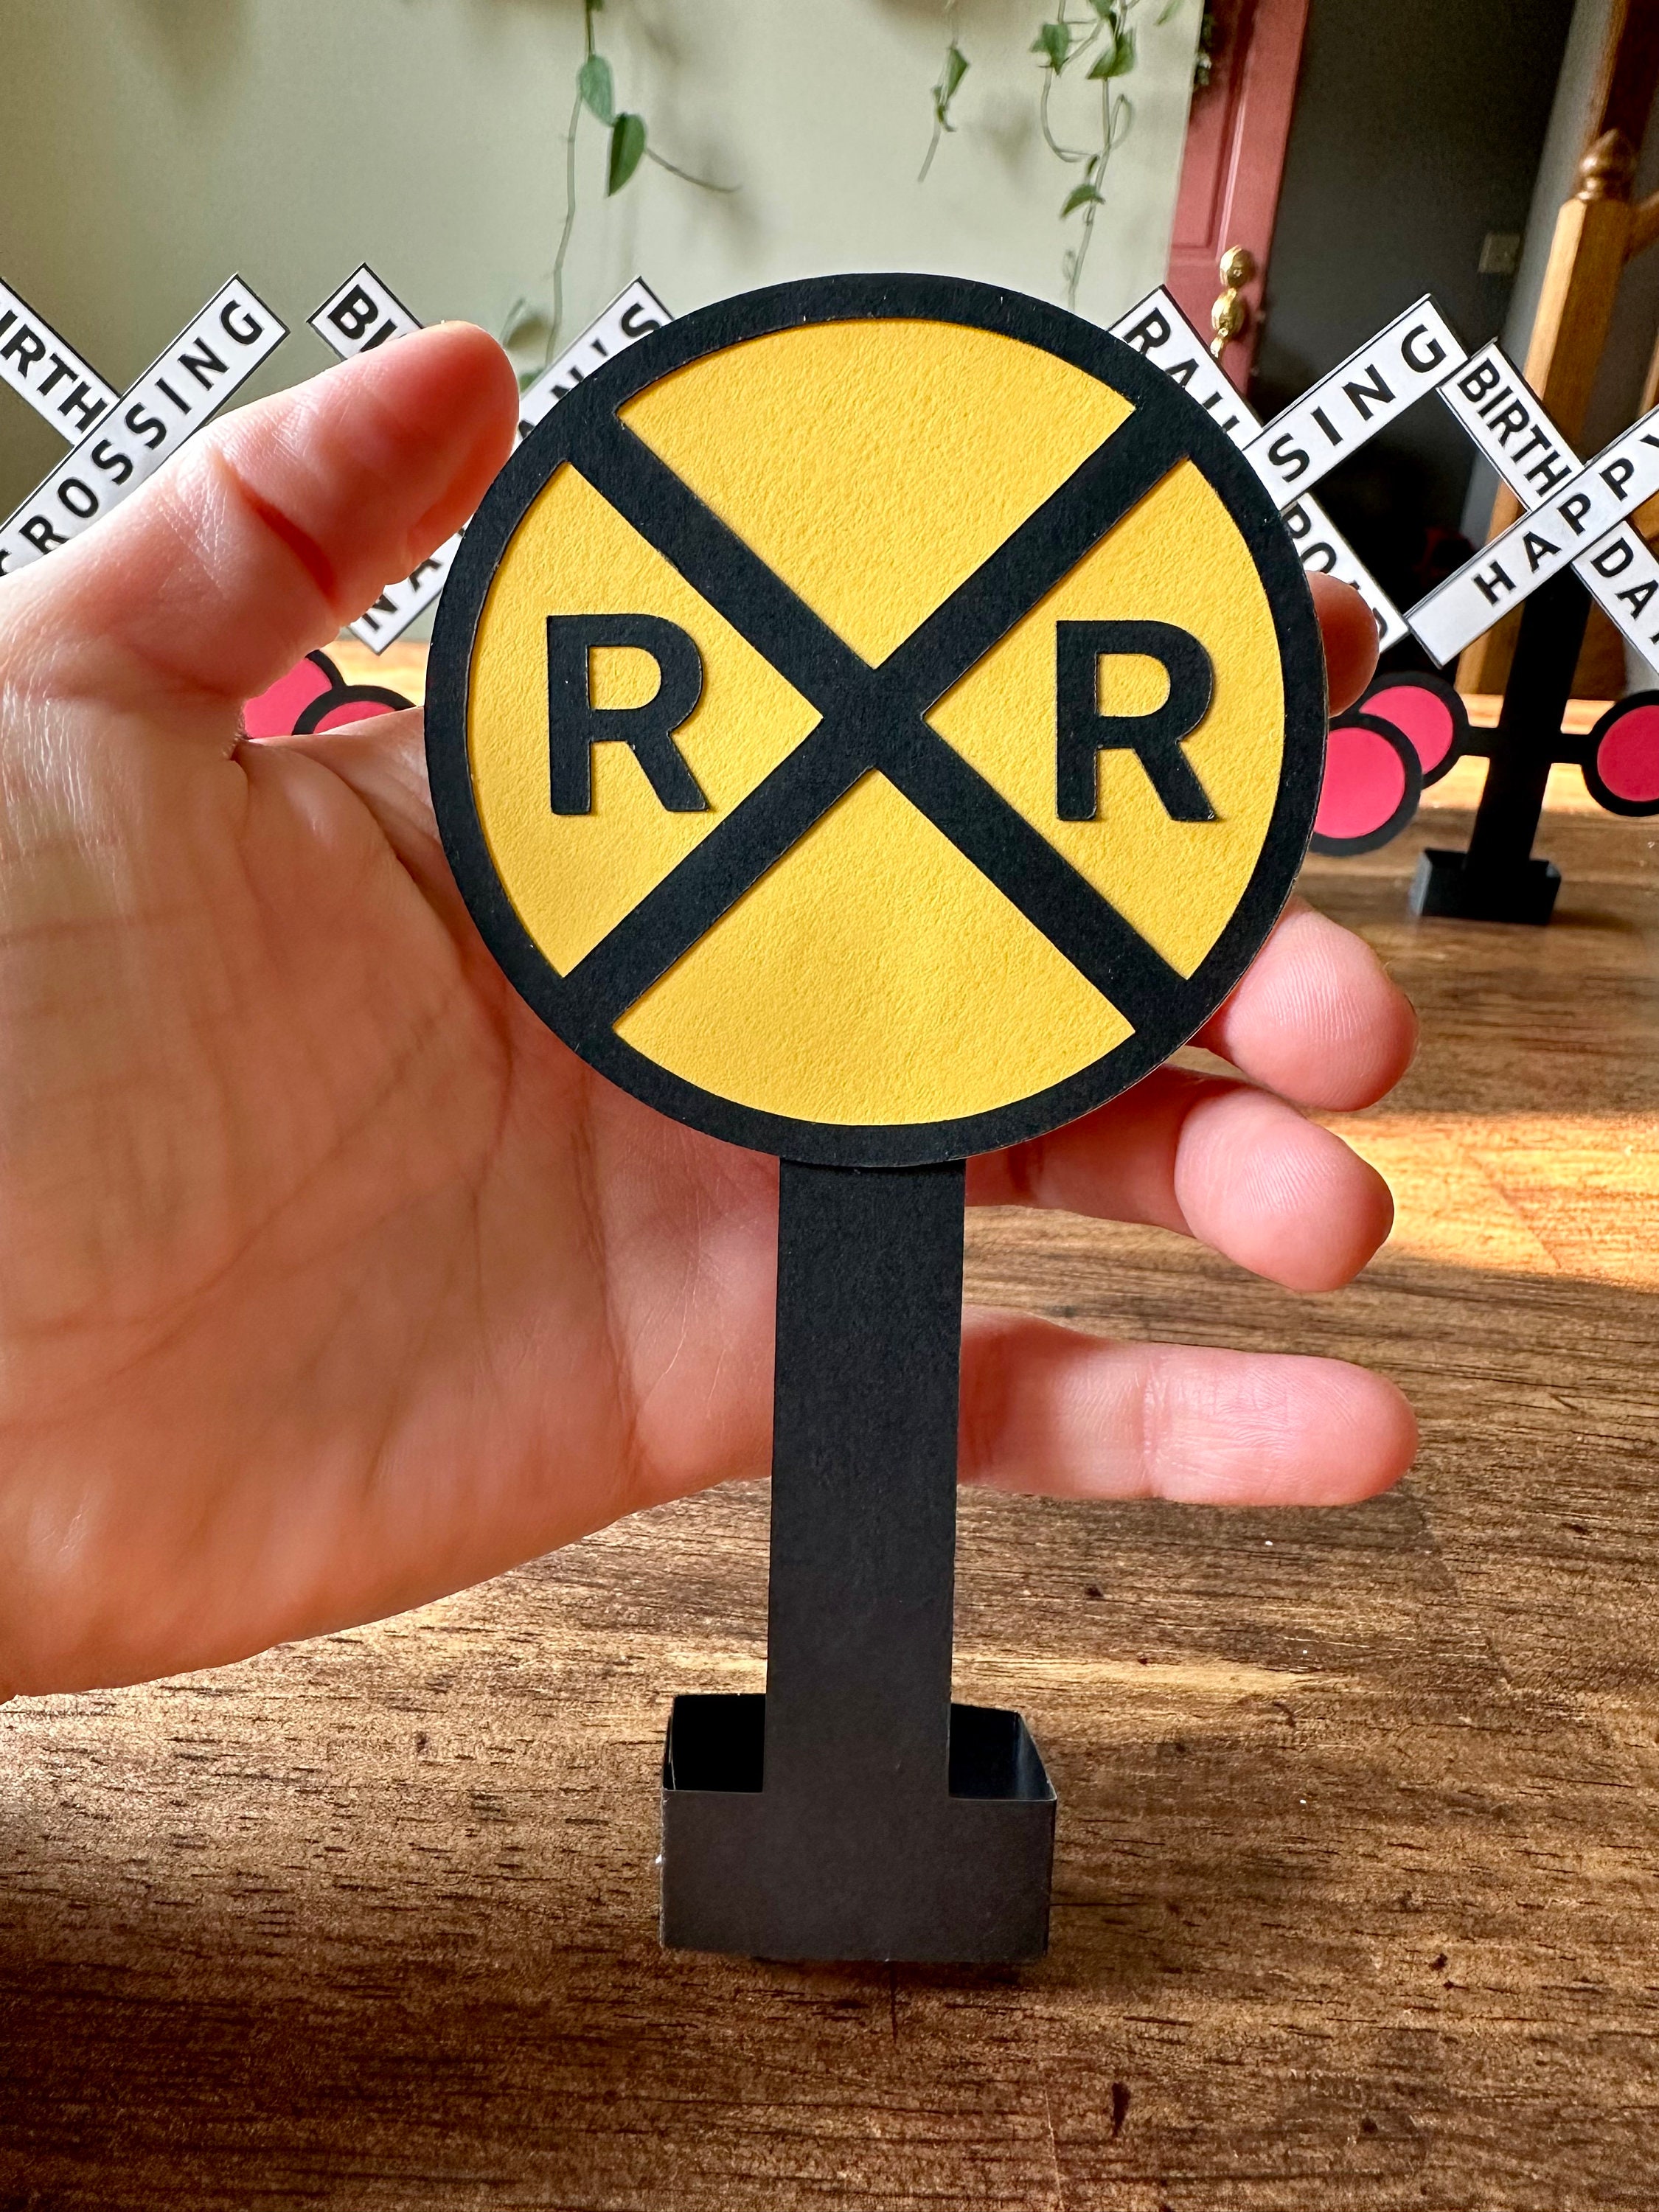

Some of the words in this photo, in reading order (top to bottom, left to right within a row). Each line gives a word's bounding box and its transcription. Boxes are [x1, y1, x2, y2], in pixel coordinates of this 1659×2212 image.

[1457, 358, 1572, 497] BIRTH
[1590, 538, 1659, 645] DA
[1472, 434, 1659, 606] HAPP
[546, 614, 709, 815] R
[1057, 620, 1218, 821] R
